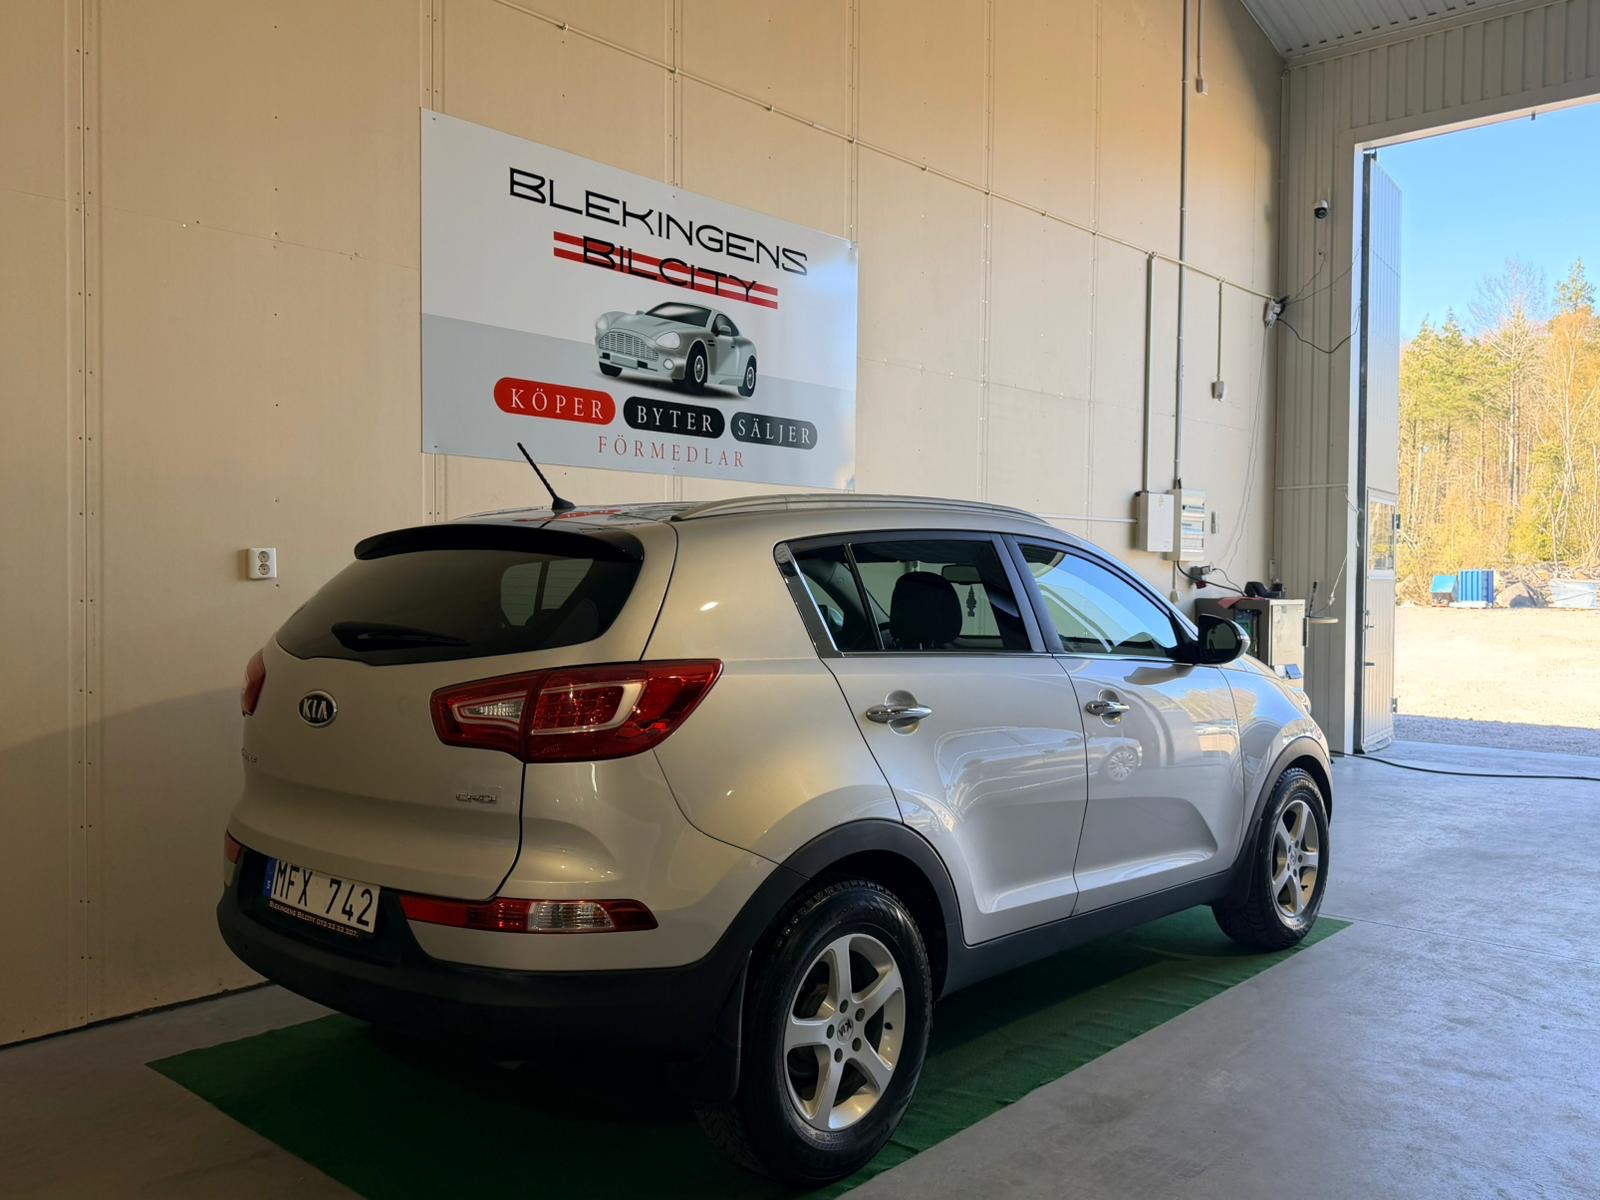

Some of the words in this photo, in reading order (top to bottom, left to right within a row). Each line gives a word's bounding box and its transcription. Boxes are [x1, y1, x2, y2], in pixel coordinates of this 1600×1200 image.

[509, 167, 808, 277] BLEKINGENS
[582, 235, 758, 302] BILCITY
[511, 387, 604, 420] KÖPER
[637, 405, 714, 433] BYTER
[738, 418, 811, 446] SÄLJER
[597, 435, 745, 468] FÖRMEDLAR
[303, 698, 328, 720] KIA
[273, 861, 313, 907] MFX
[325, 878, 373, 928] 742
[838, 1018, 852, 1037] KIA
